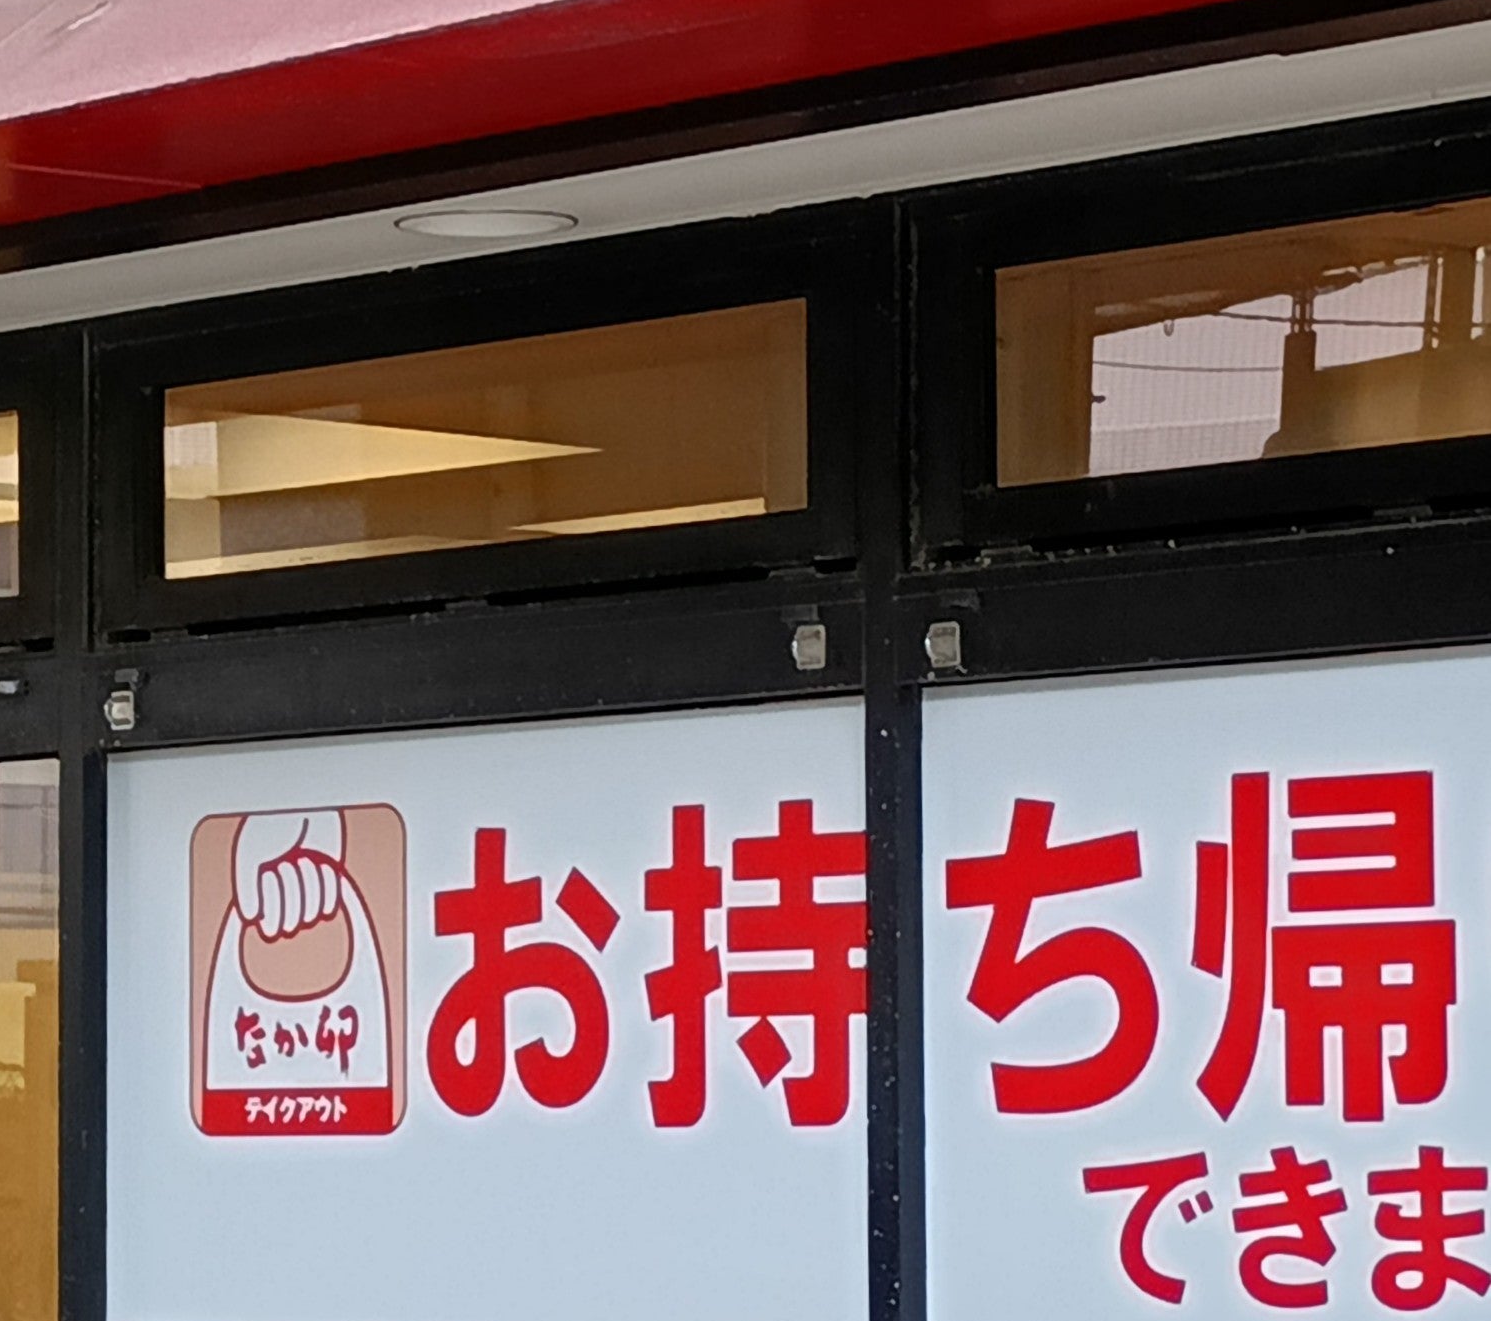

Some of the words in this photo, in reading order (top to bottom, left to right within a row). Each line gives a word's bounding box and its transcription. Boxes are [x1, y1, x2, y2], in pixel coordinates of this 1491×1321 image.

[234, 1004, 360, 1078] なか卯
[244, 1094, 348, 1124] テイクアウト
[1082, 1145, 1491, 1312] できま
